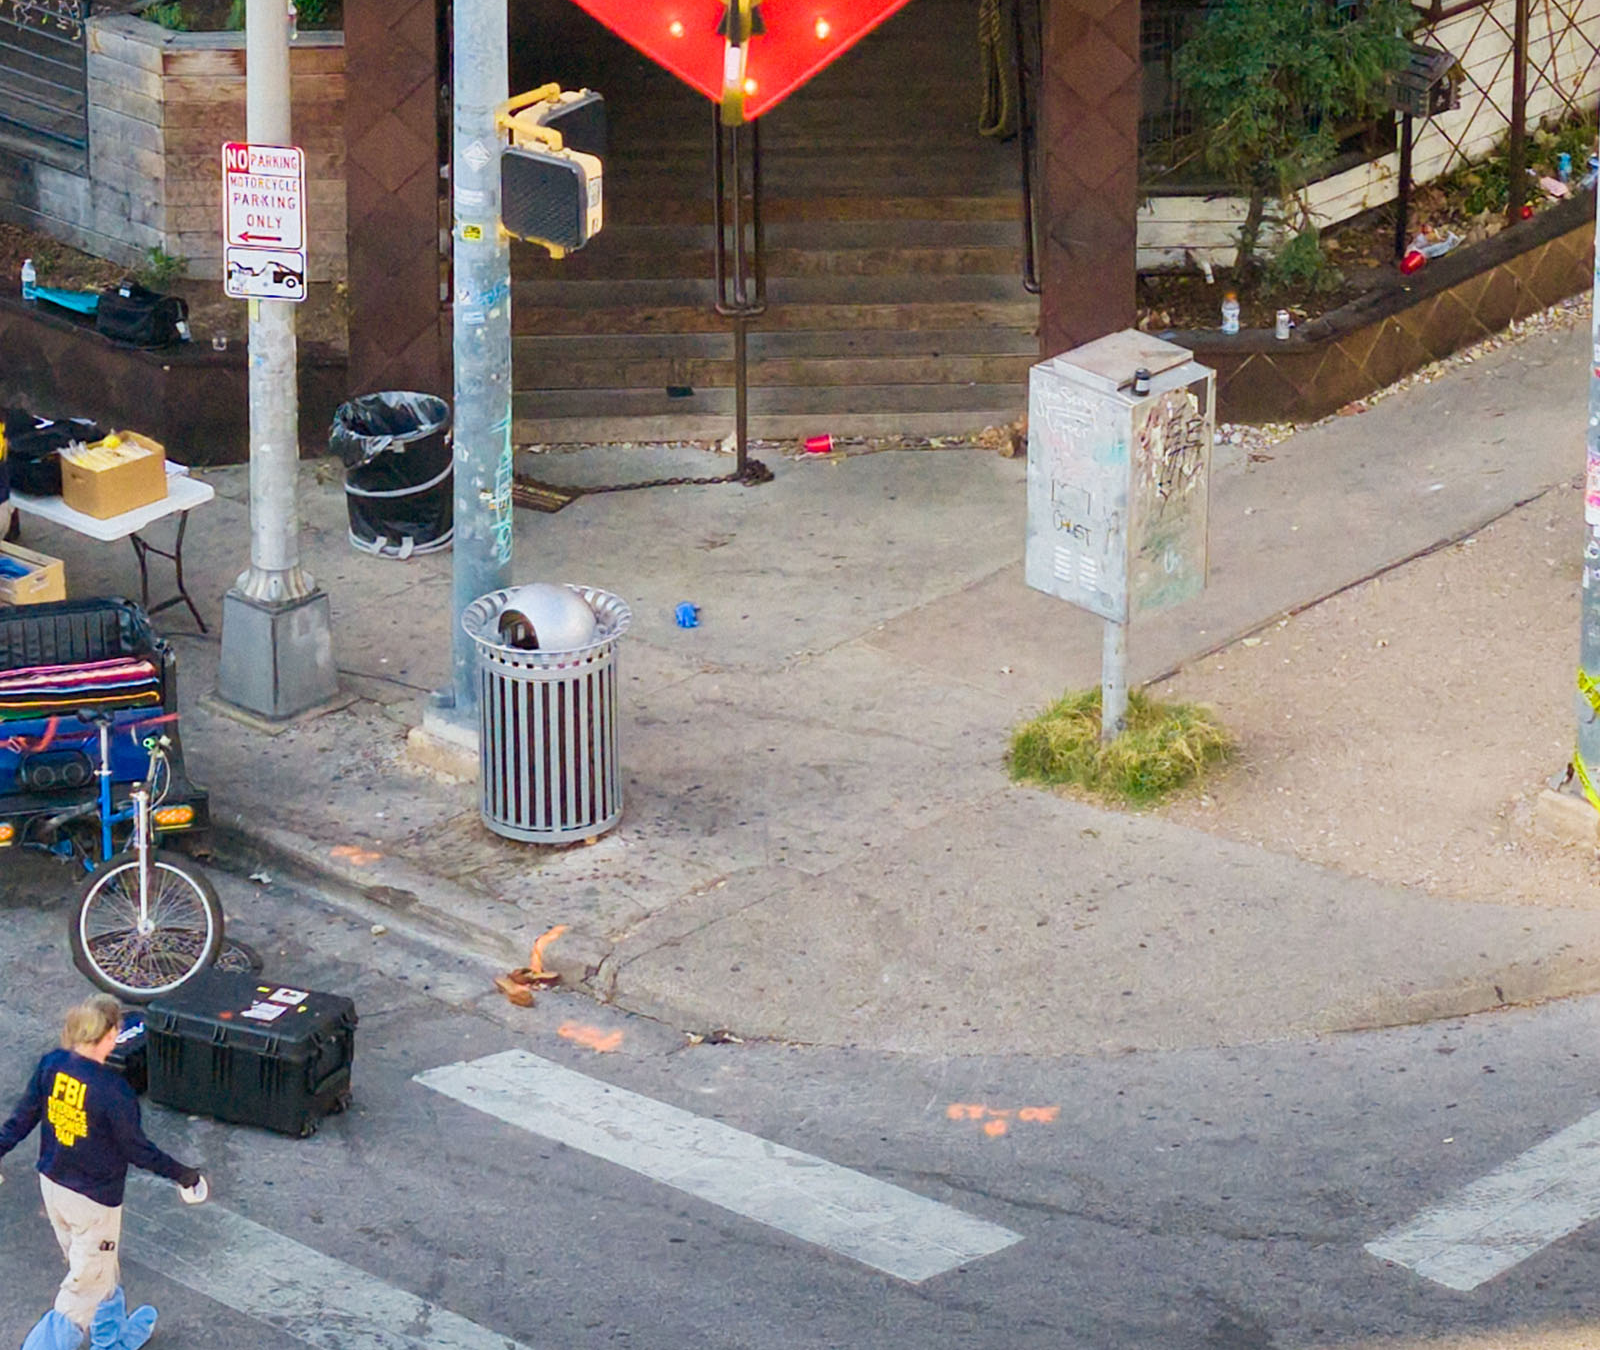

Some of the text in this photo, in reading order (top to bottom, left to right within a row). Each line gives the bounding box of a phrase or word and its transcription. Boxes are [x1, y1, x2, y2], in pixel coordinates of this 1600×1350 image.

[227, 147, 298, 170] NO PARKING
[230, 175, 298, 192] MOTORCYCLE
[233, 192, 296, 210] PARKING
[246, 213, 283, 230] ONLY
[52, 1072, 87, 1110] FBI
